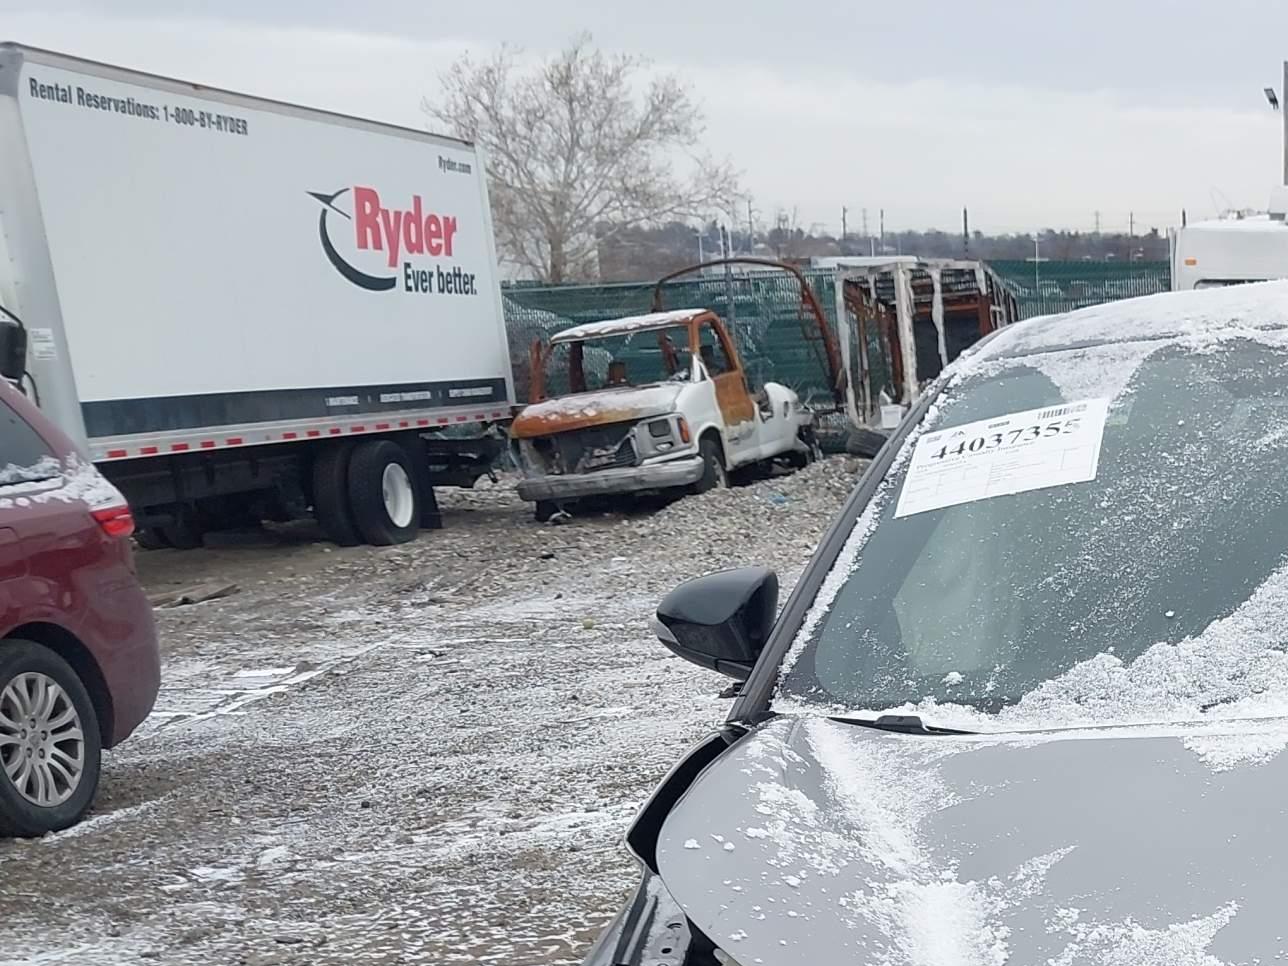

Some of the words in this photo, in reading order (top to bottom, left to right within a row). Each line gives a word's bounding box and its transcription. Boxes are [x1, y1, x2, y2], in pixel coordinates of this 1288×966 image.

[29, 77, 72, 105] Rental
[75, 86, 160, 121] Reservations:
[162, 105, 249, 136] 1-800-BY-RYDER
[438, 155, 472, 175] Ryder.com
[353, 186, 457, 268] Ryder
[403, 261, 434, 293] Ever
[436, 264, 478, 296] better.
[930, 417, 1082, 460] 44037355
